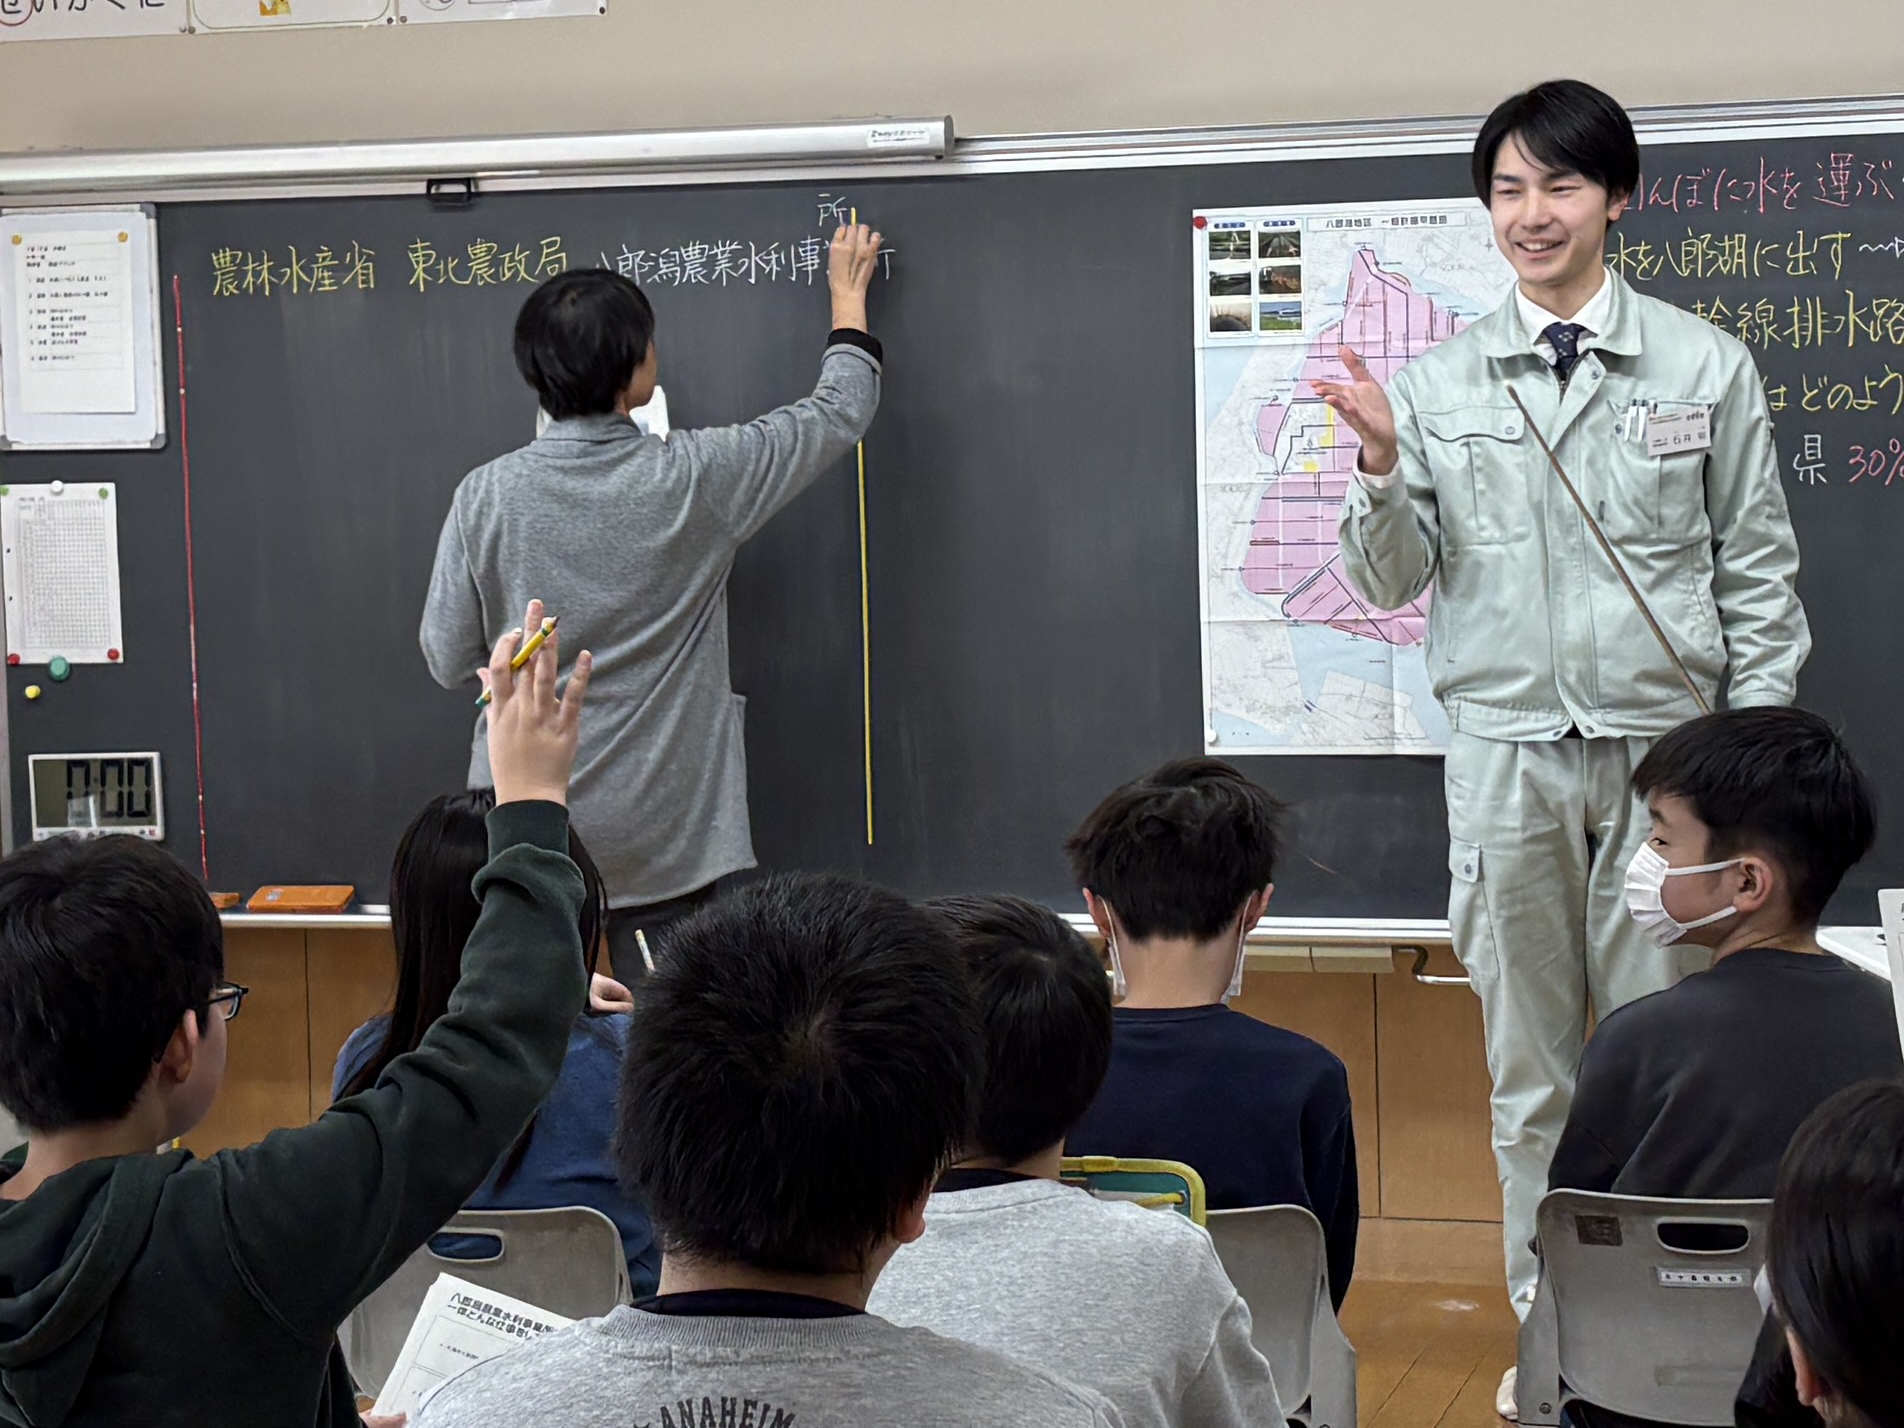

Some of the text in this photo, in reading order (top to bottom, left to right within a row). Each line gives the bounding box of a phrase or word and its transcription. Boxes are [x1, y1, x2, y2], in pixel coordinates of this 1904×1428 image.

[211, 240, 376, 297] 農林水産省
[408, 236, 569, 292] 東北農政局
[1792, 434, 1828, 486] 県
